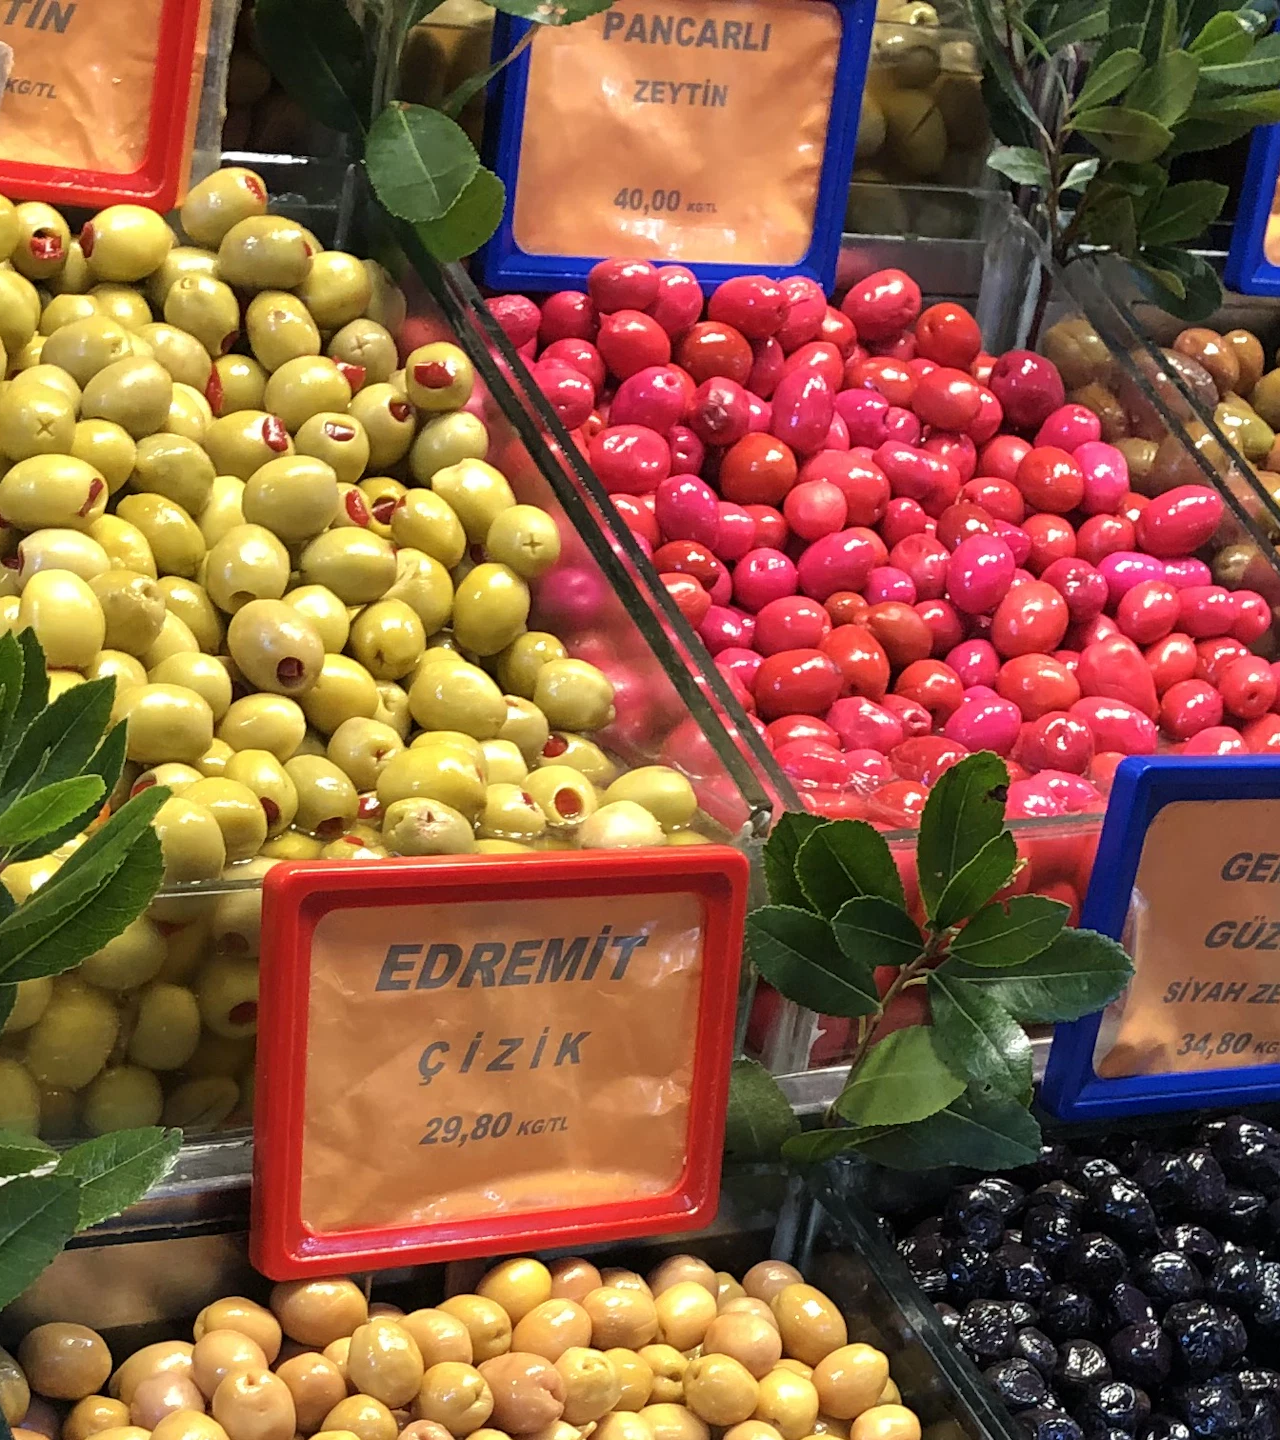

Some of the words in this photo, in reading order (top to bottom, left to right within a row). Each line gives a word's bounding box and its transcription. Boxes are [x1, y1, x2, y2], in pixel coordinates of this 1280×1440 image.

[603, 12, 772, 52] PANCARLI
[632, 79, 730, 108] ZEYTİN
[612, 187, 681, 213] 40,00
[374, 923, 650, 992] EDREMİT
[1162, 976, 1248, 1005] SİYAH
[417, 1026, 592, 1086] ÇİZİK
[1176, 1031, 1254, 1061] 34,80
[418, 1111, 513, 1146] 29,80
[515, 1115, 570, 1136] KG/TL
